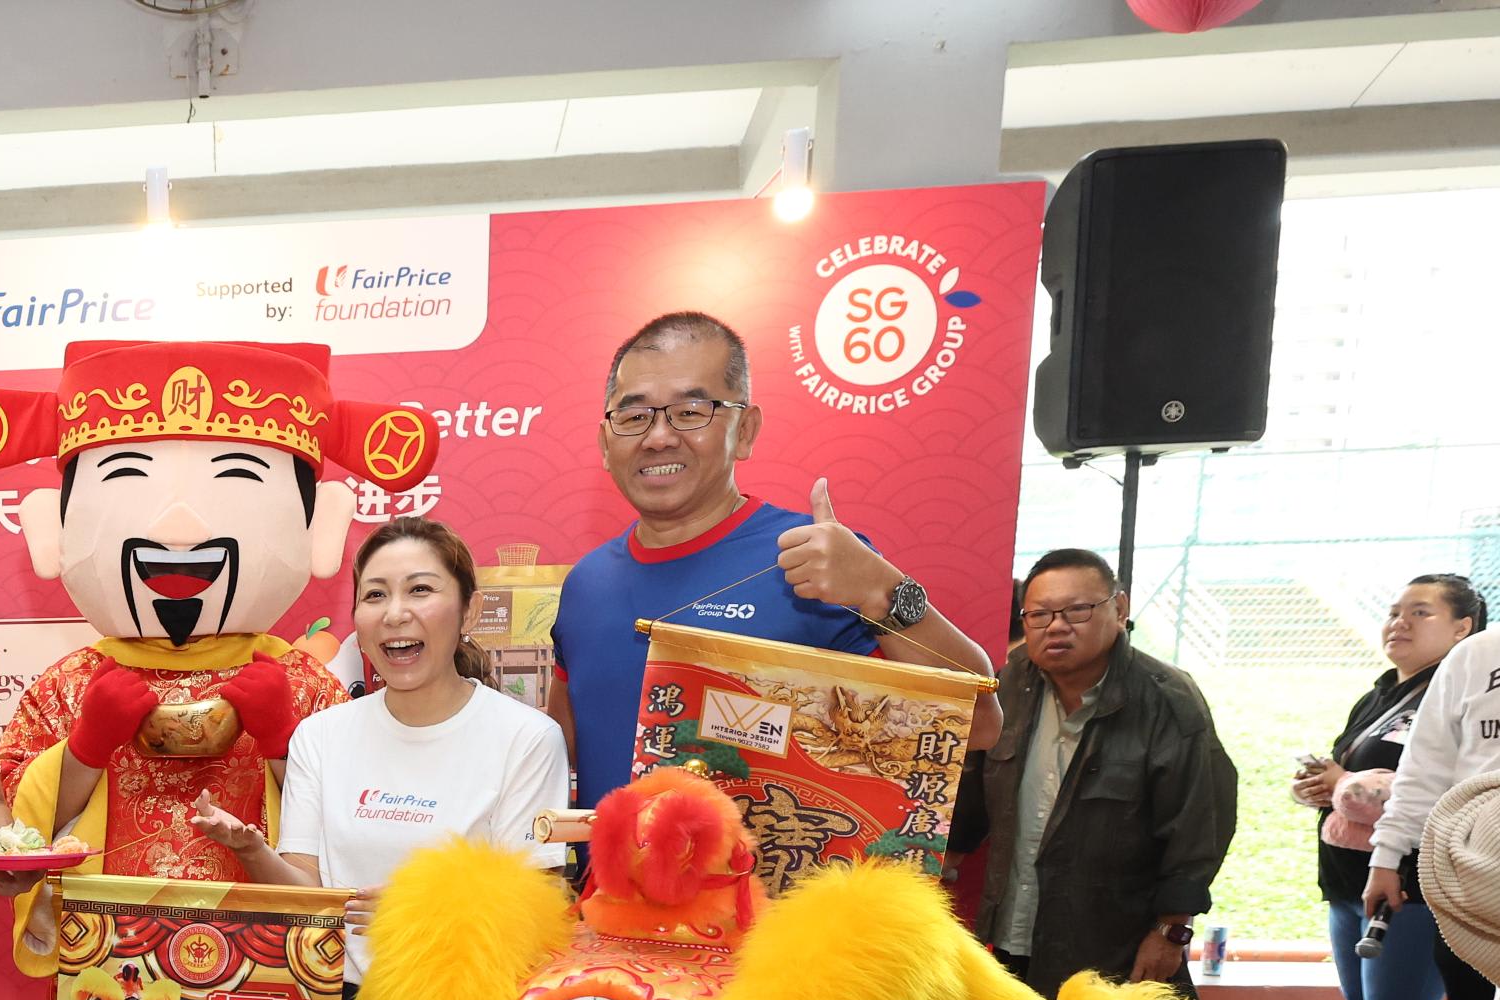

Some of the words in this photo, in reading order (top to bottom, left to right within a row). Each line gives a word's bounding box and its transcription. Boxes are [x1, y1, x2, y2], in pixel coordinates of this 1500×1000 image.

[816, 235, 947, 278] CELEBRATE
[196, 277, 293, 299] Supported
[352, 266, 452, 289] FairPrice
[266, 303, 293, 322] by:
[315, 294, 451, 321] foundation
[846, 286, 908, 323] SG
[789, 324, 805, 362] WITH
[843, 325, 905, 364] 60
[912, 315, 967, 396] GROUP
[168, 374, 206, 420] 财
[795, 362, 910, 414] FAIRPRICE
[399, 401, 543, 438] etter
[692, 603, 726, 611] FairPrice
[698, 609, 723, 618] Group
[711, 724, 748, 738] INTERIOR
[750, 733, 779, 745] DESIGN
[379, 792, 437, 808] FairPrice
[354, 806, 434, 823] foundation
